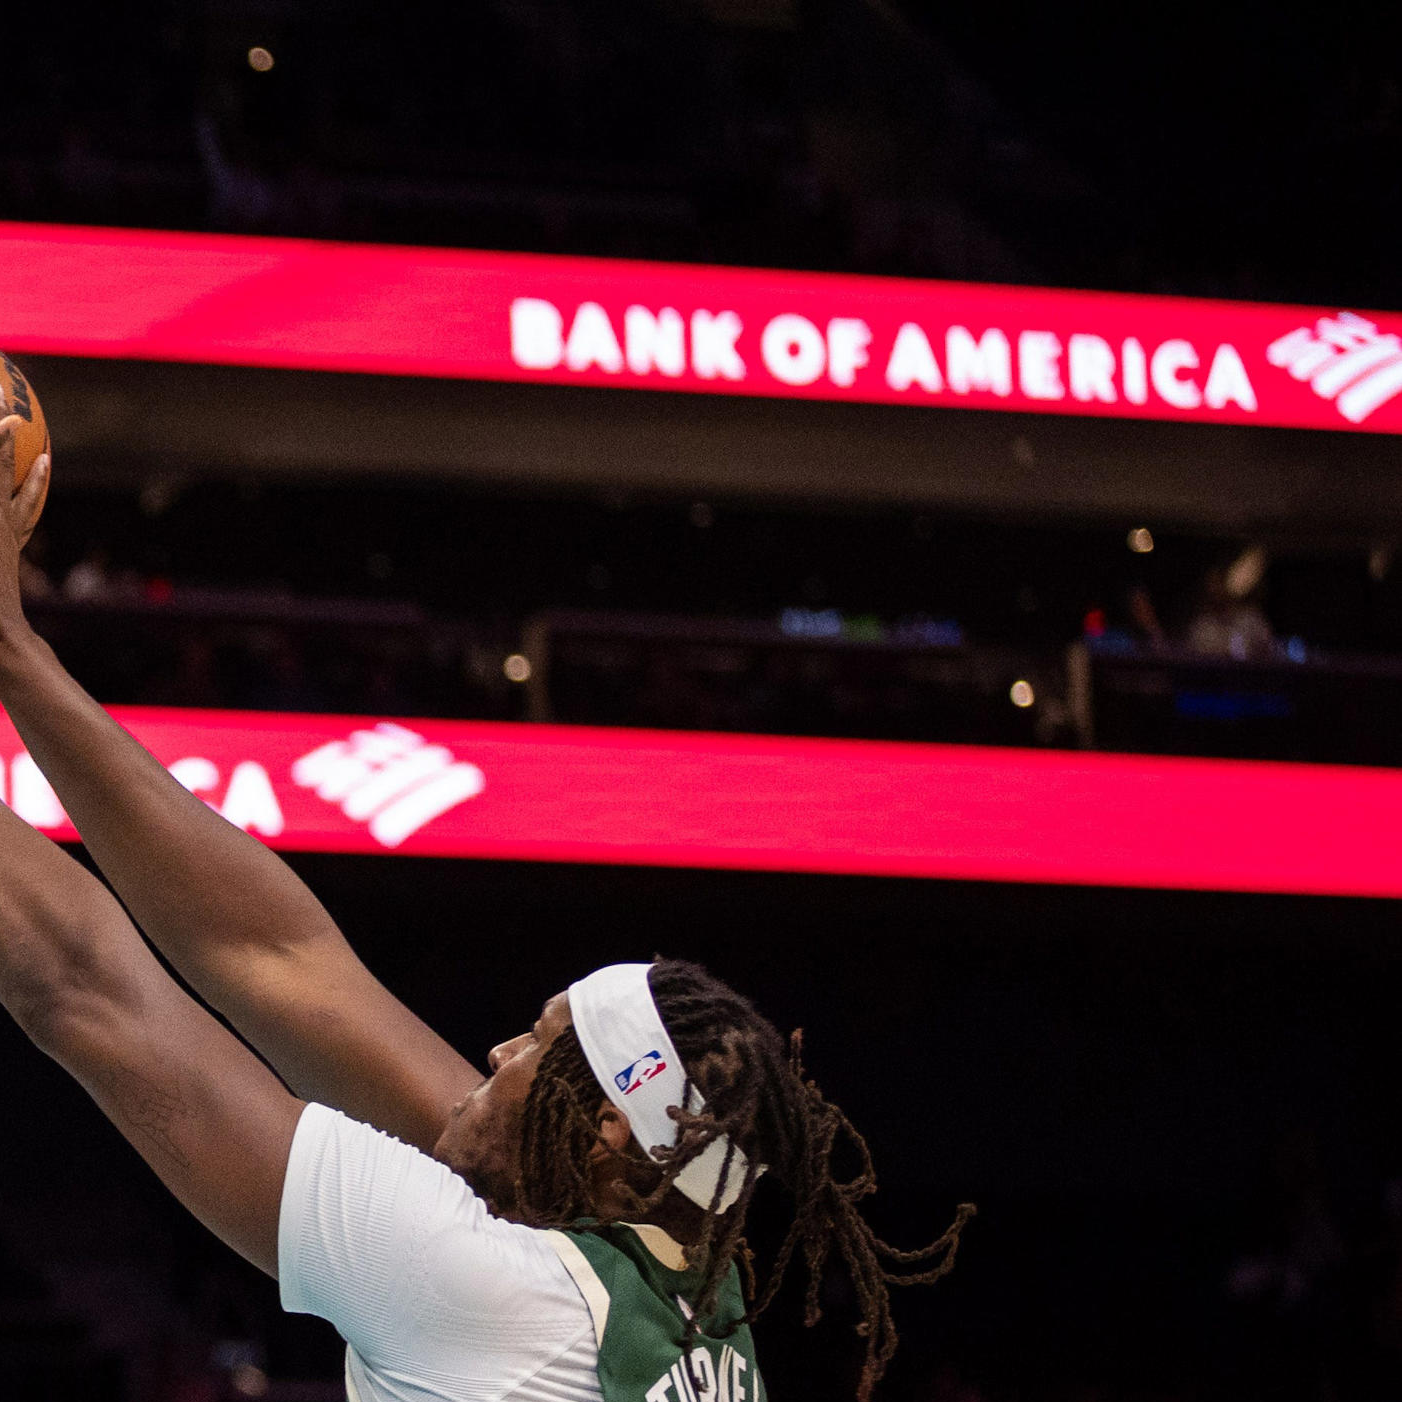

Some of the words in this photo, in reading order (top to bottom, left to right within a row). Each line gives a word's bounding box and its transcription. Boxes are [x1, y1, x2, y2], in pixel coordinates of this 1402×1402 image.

[510, 296, 747, 381] BANK
[760, 312, 873, 388] OF
[886, 321, 1259, 413] AMERICA
